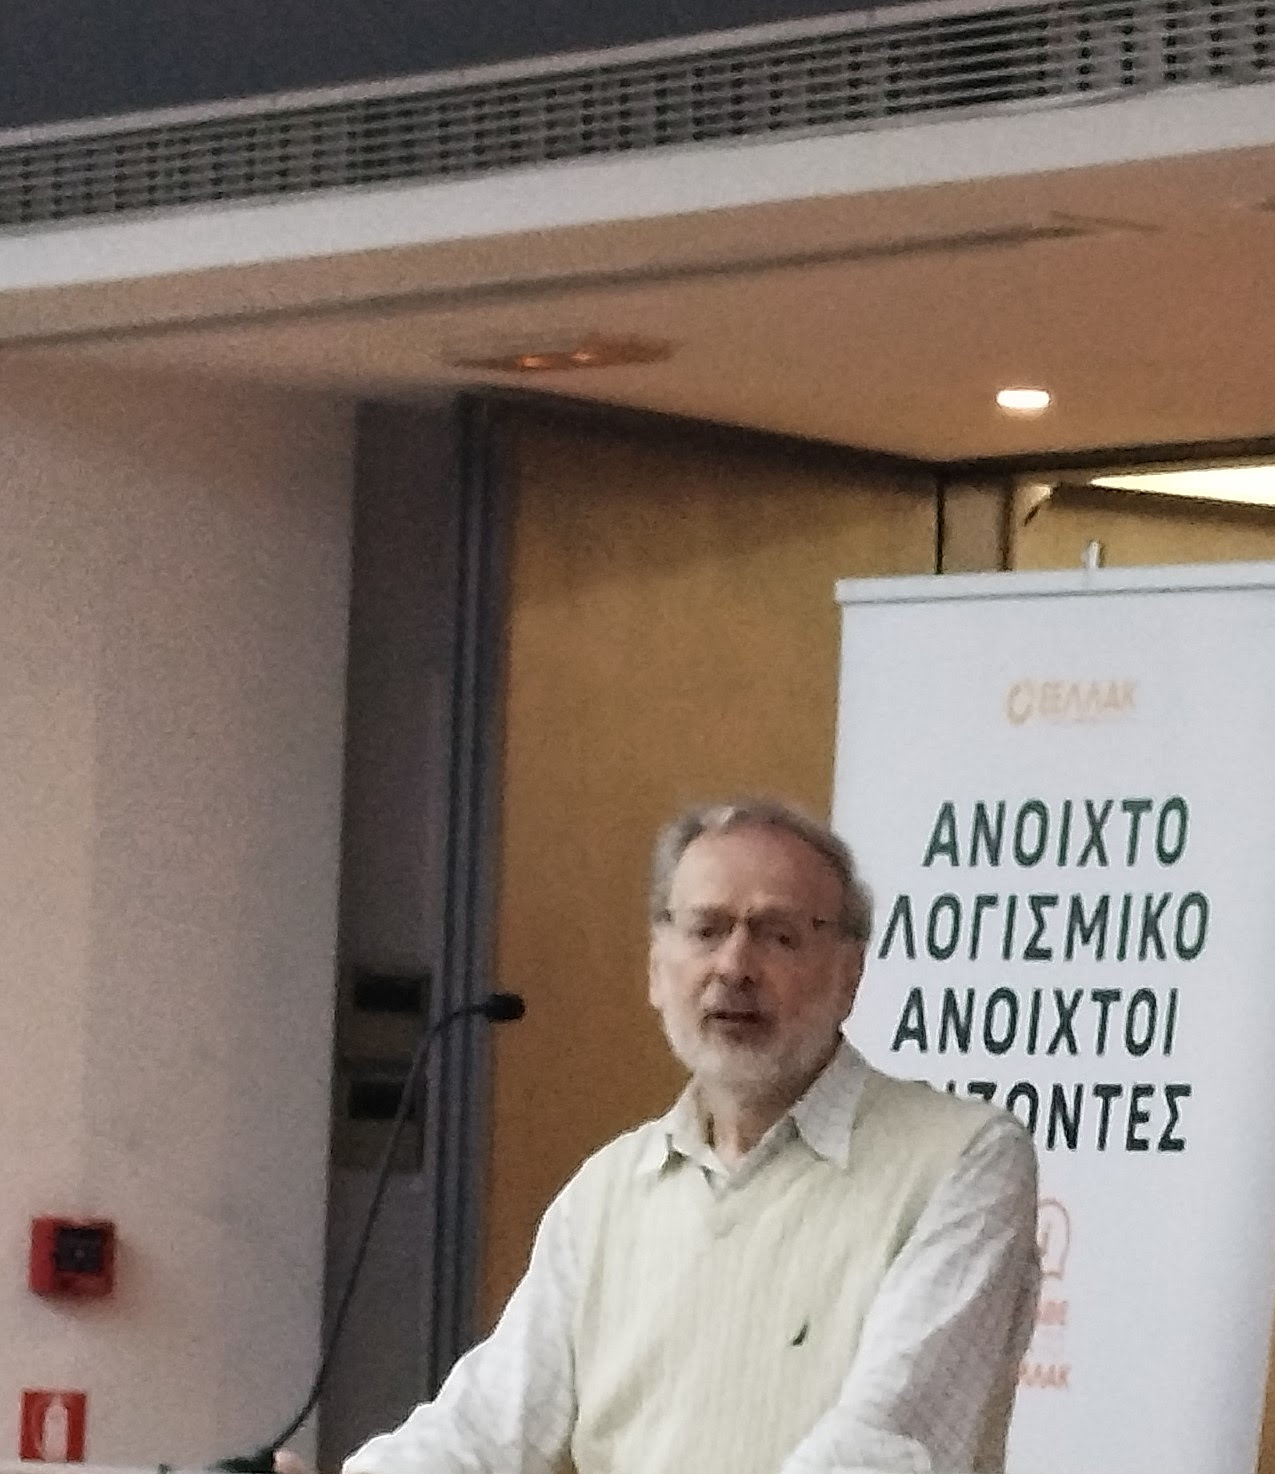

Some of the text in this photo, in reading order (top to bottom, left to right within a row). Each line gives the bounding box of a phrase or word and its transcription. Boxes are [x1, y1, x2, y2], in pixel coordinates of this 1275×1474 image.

[920, 795, 1190, 868] ΑΝΟΙΧΤΟ
[877, 891, 1211, 961] ΛΟΓΙΣΜΙΚΟ
[890, 987, 1179, 1056] ΑΝΟΙΧΤΟΙ
[912, 1080, 1191, 1151] ΟΝΤΕΣ
